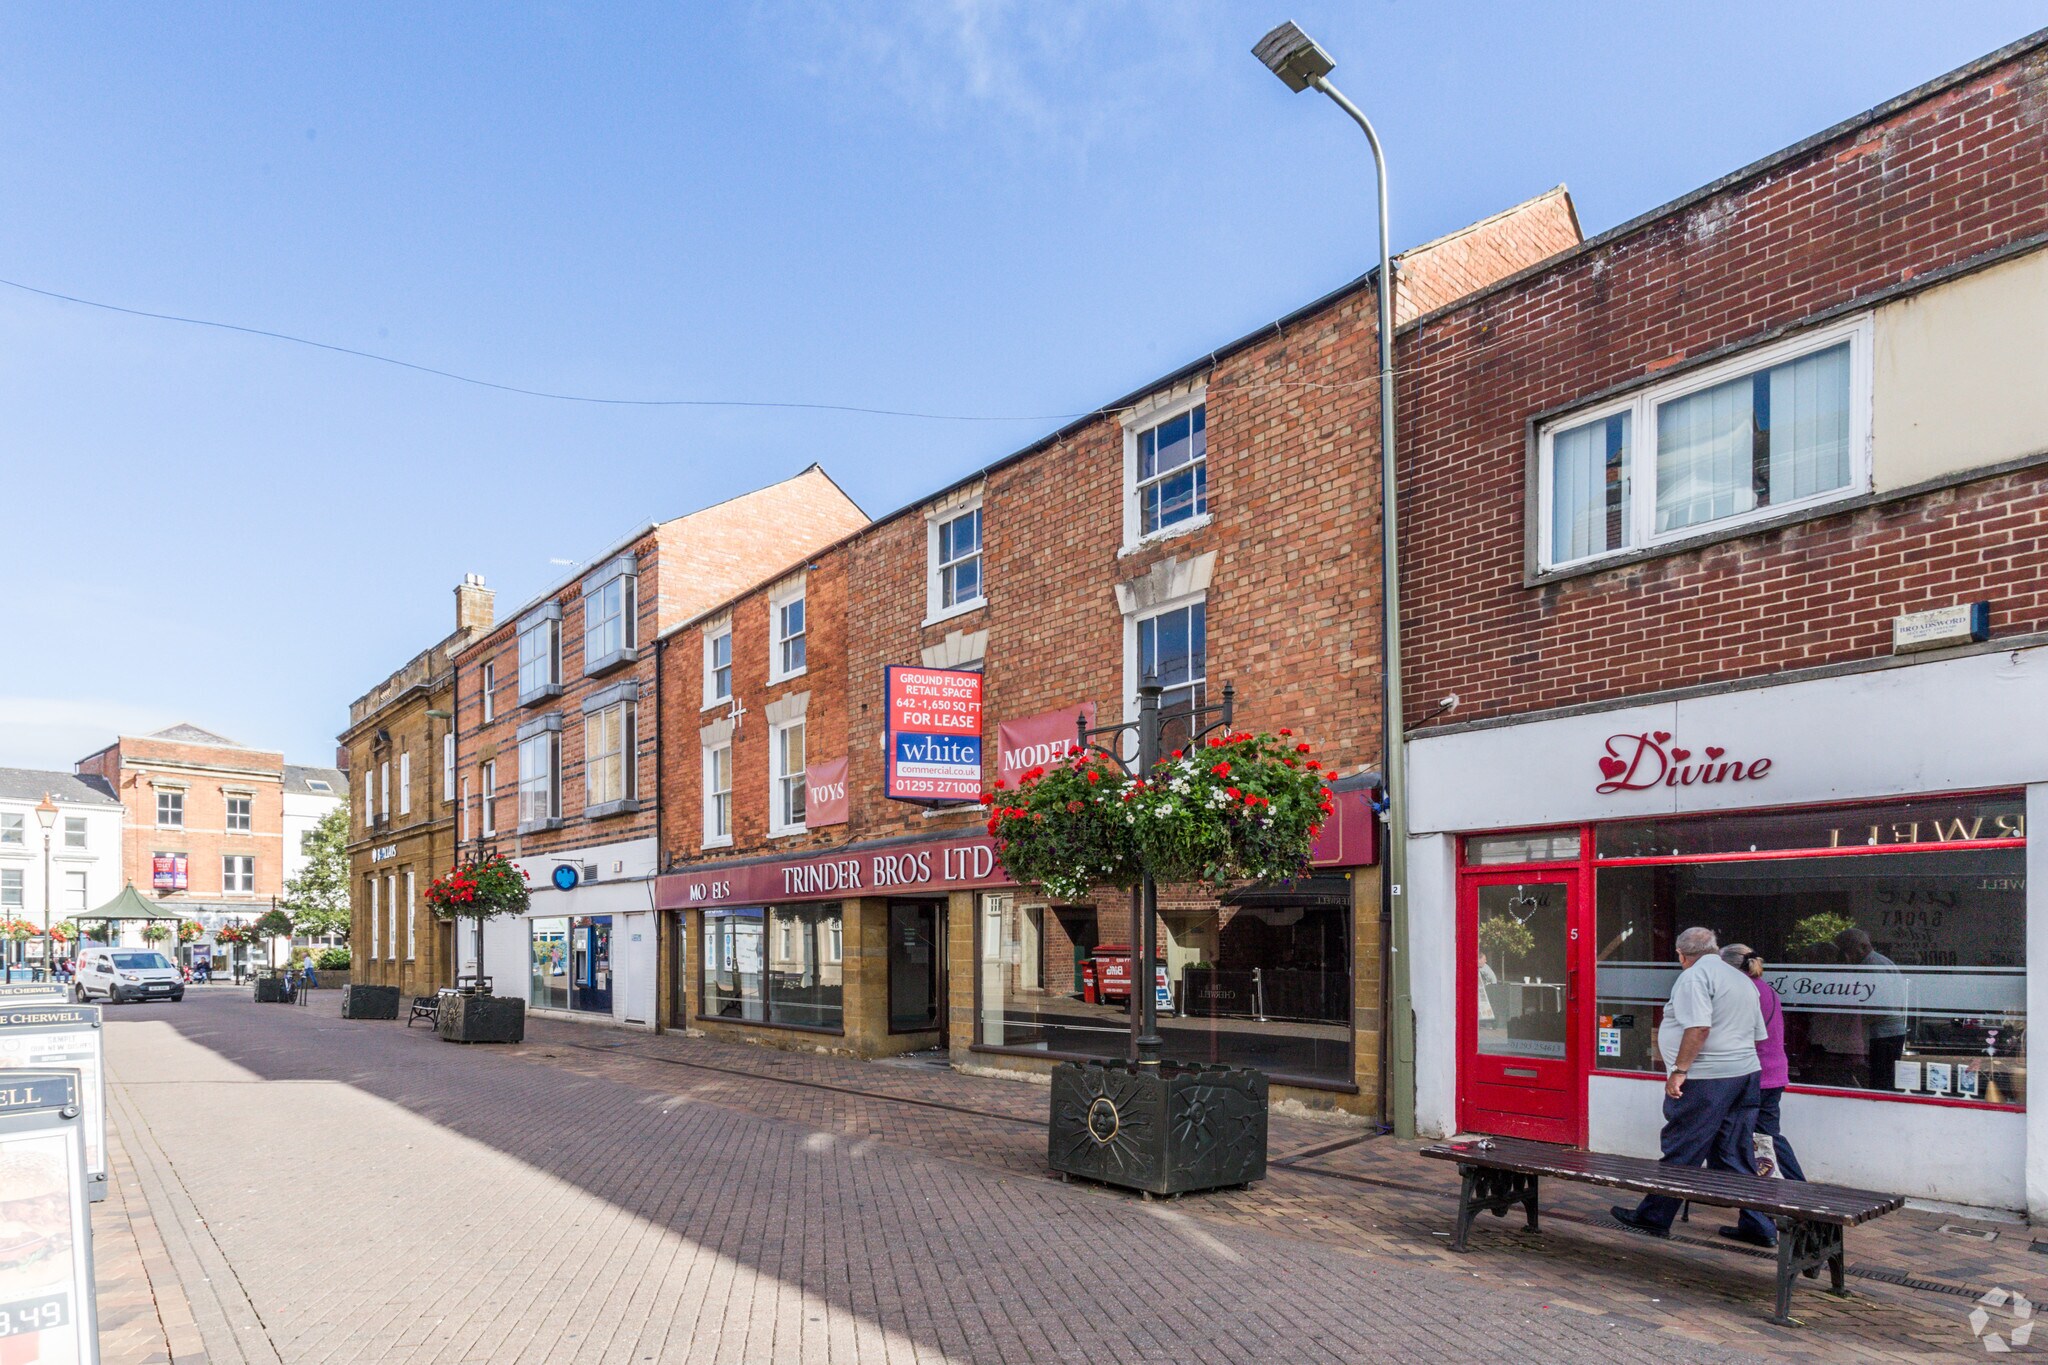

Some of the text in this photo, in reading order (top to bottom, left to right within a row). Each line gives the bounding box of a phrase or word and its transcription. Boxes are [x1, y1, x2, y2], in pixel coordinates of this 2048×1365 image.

[1900, 617, 1966, 632] BROADSWORD
[900, 673, 978, 688] GROUND FLOOR
[906, 685, 972, 699] RETAIL SPACE
[896, 698, 915, 708] 642
[953, 701, 967, 713] SQ
[969, 702, 981, 712] FT
[903, 712, 975, 728] FOR LEASE
[902, 736, 974, 763] white
[902, 765, 976, 776] commercial.co.uk
[1596, 732, 1772, 794] Divine
[812, 781, 845, 804] TOYS
[896, 780, 981, 794] 01295 271000
[782, 845, 994, 894] TRINDER BROS LTD
[1393, 886, 1398, 894] 2
[1570, 928, 1578, 940] 5
[13, 986, 57, 994] CHERWELL
[1793, 978, 1876, 1002] Beauty
[10, 1012, 83, 1024] CHERWELL
